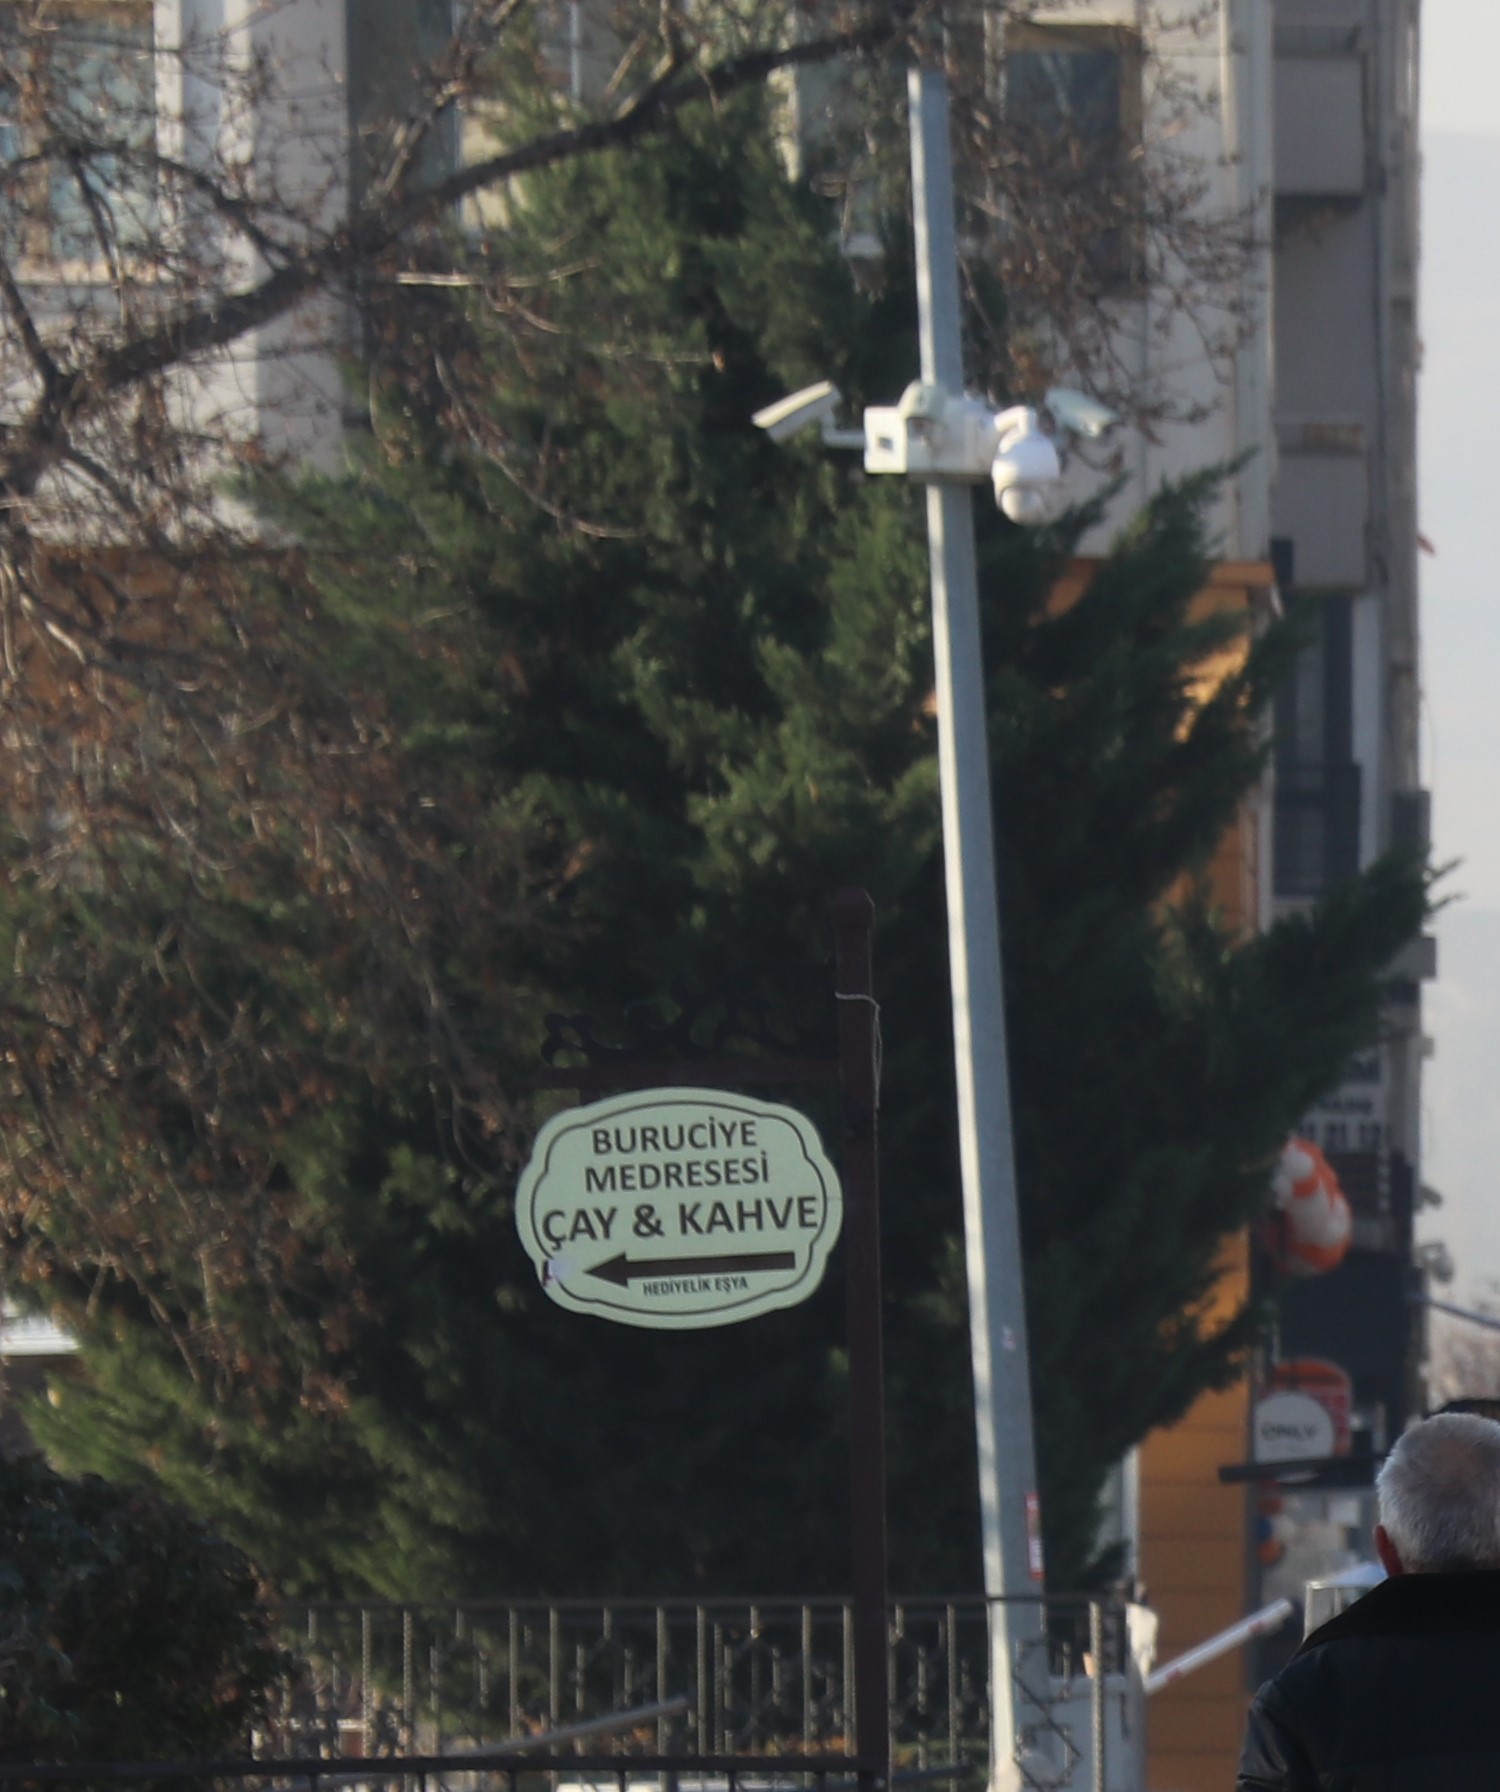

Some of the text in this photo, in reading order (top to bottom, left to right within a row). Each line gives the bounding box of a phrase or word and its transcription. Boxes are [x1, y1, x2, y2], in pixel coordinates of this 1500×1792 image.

[591, 1116, 758, 1156] BURUCİYE
[584, 1150, 770, 1193] MEDRESESİ
[541, 1195, 818, 1252] ÇAY & KAHVE
[642, 1276, 749, 1297] HEDİYELİK EŞYA
